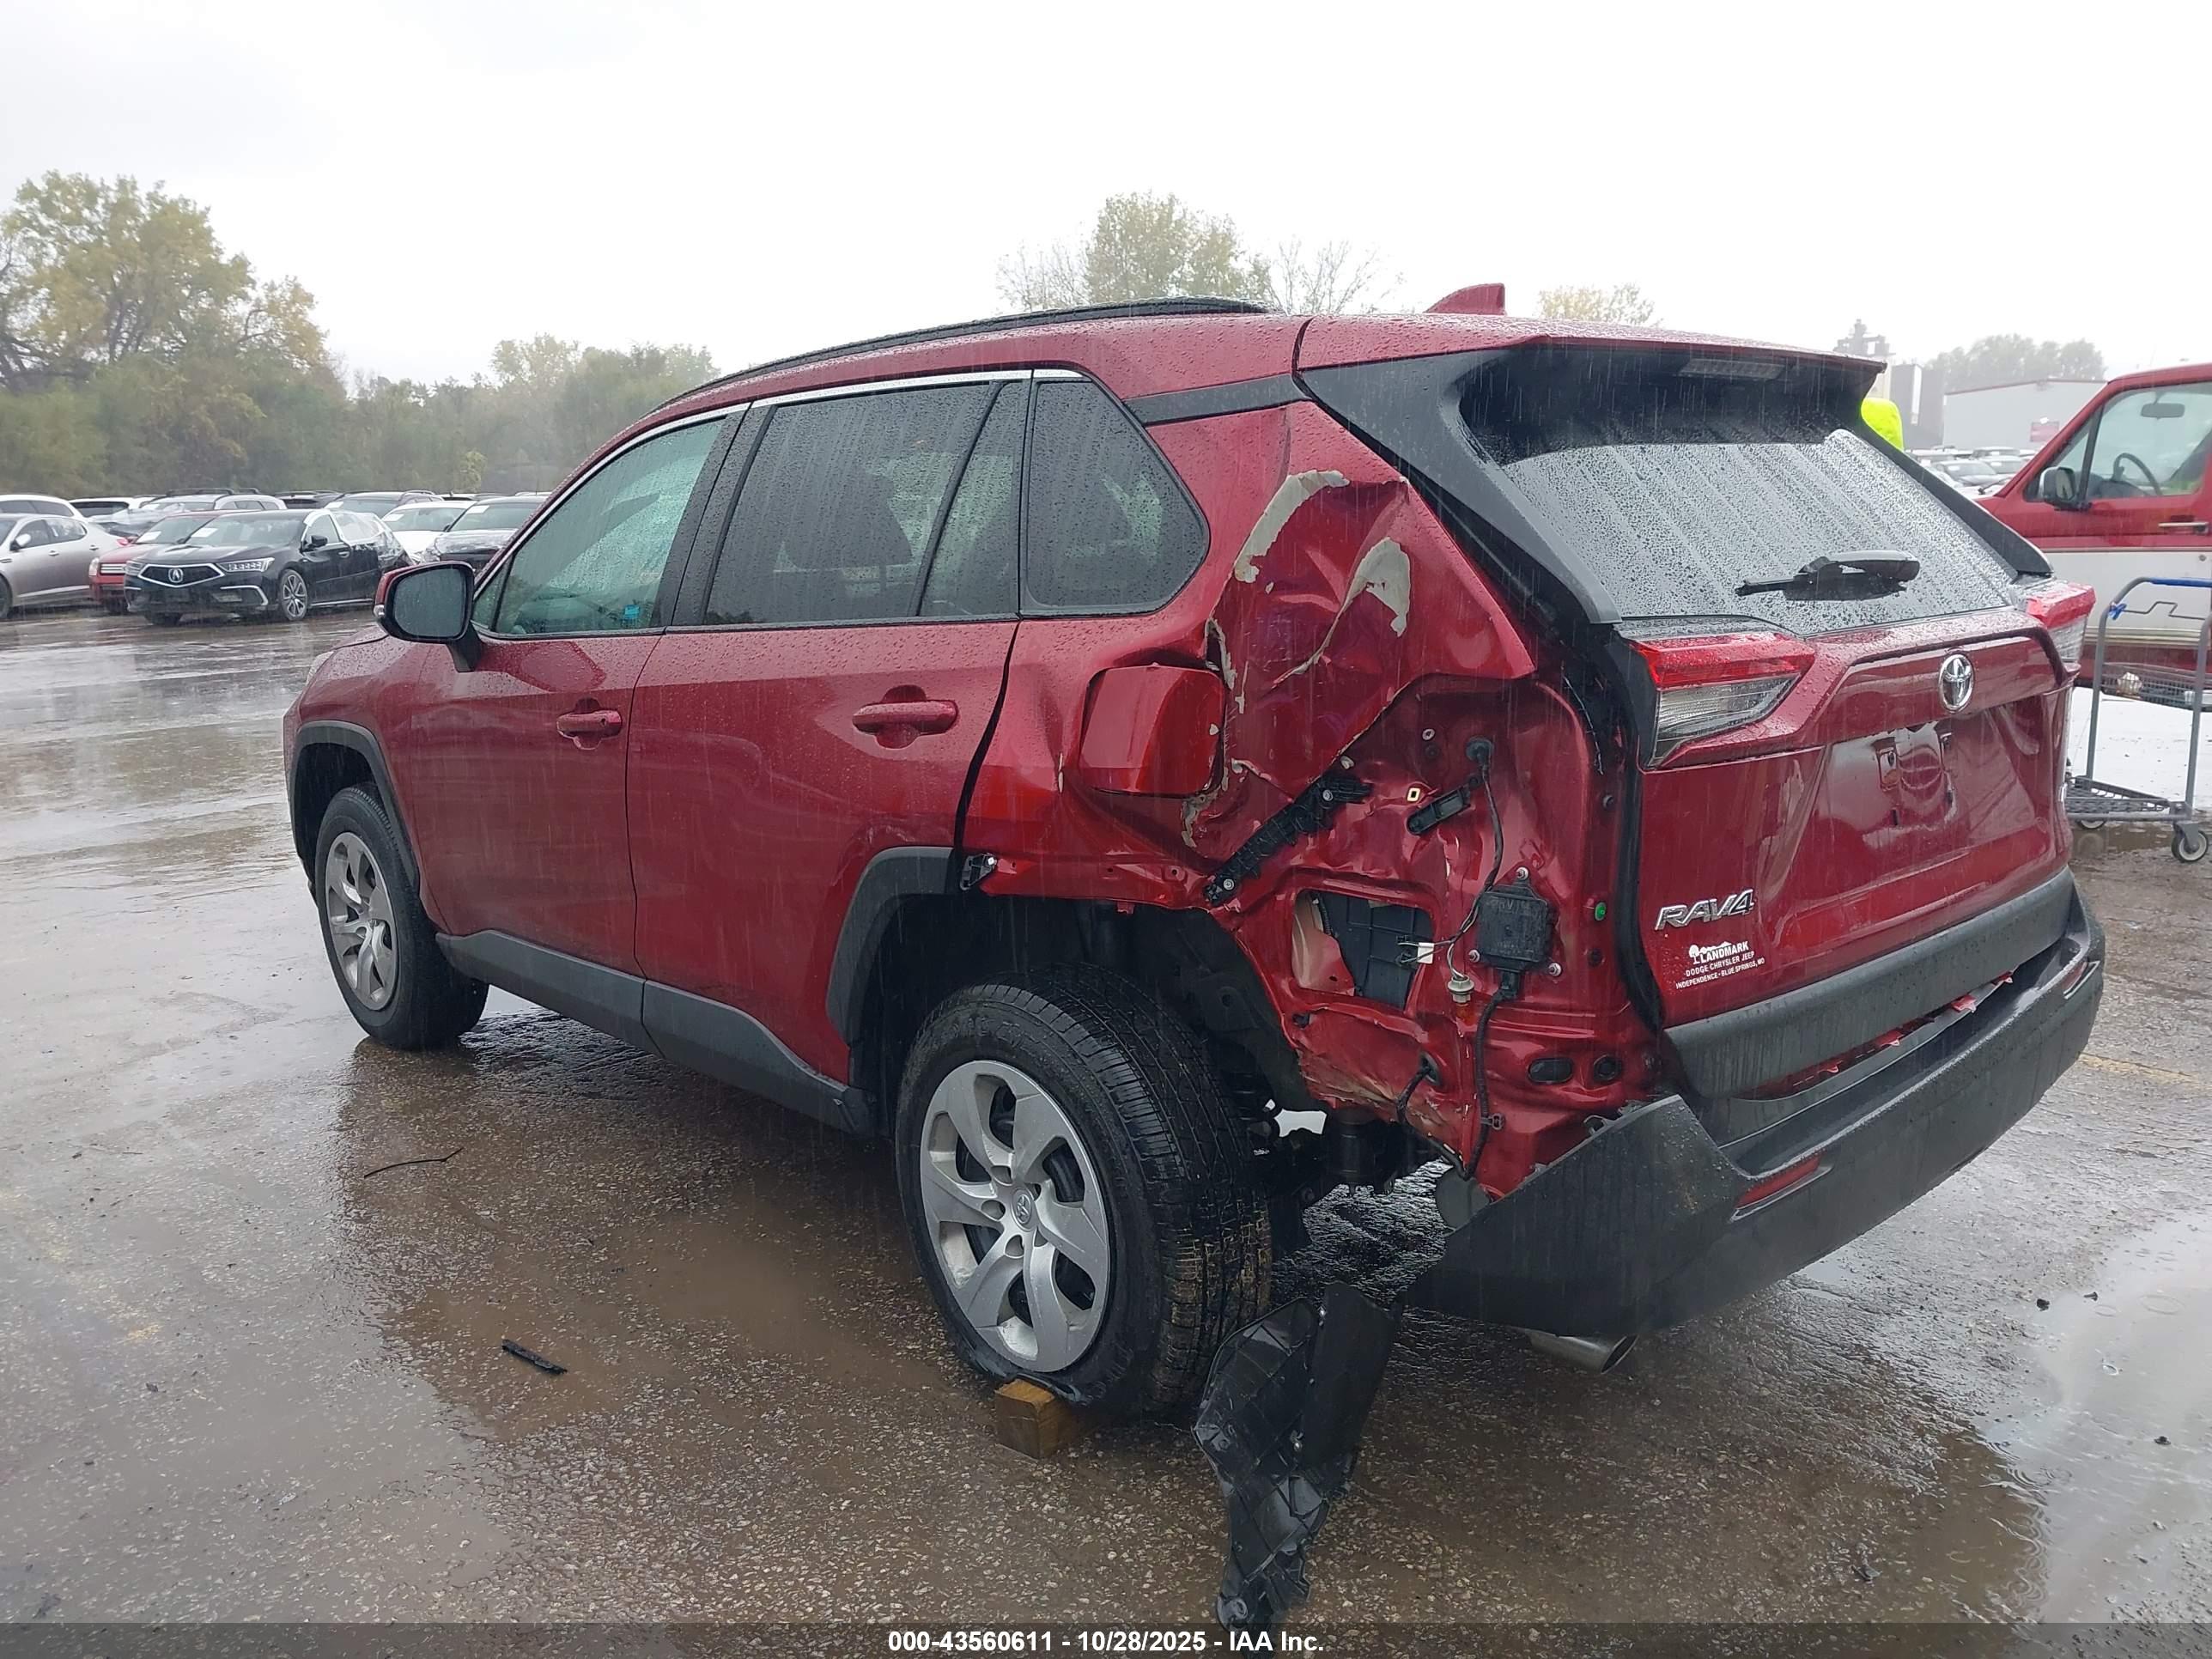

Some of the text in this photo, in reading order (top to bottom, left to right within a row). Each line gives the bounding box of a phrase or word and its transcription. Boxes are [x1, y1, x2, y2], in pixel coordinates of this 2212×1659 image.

[1654, 889, 1754, 930] RAV4
[1686, 951, 1755, 977] DODGE CHRYSLER JEEP
[1700, 940, 1749, 963] LANDMARK
[1675, 972, 1718, 989] INDEPENDENCE
[1721, 968, 1735, 977] BLUE
[1758, 957, 1765, 965] MO
